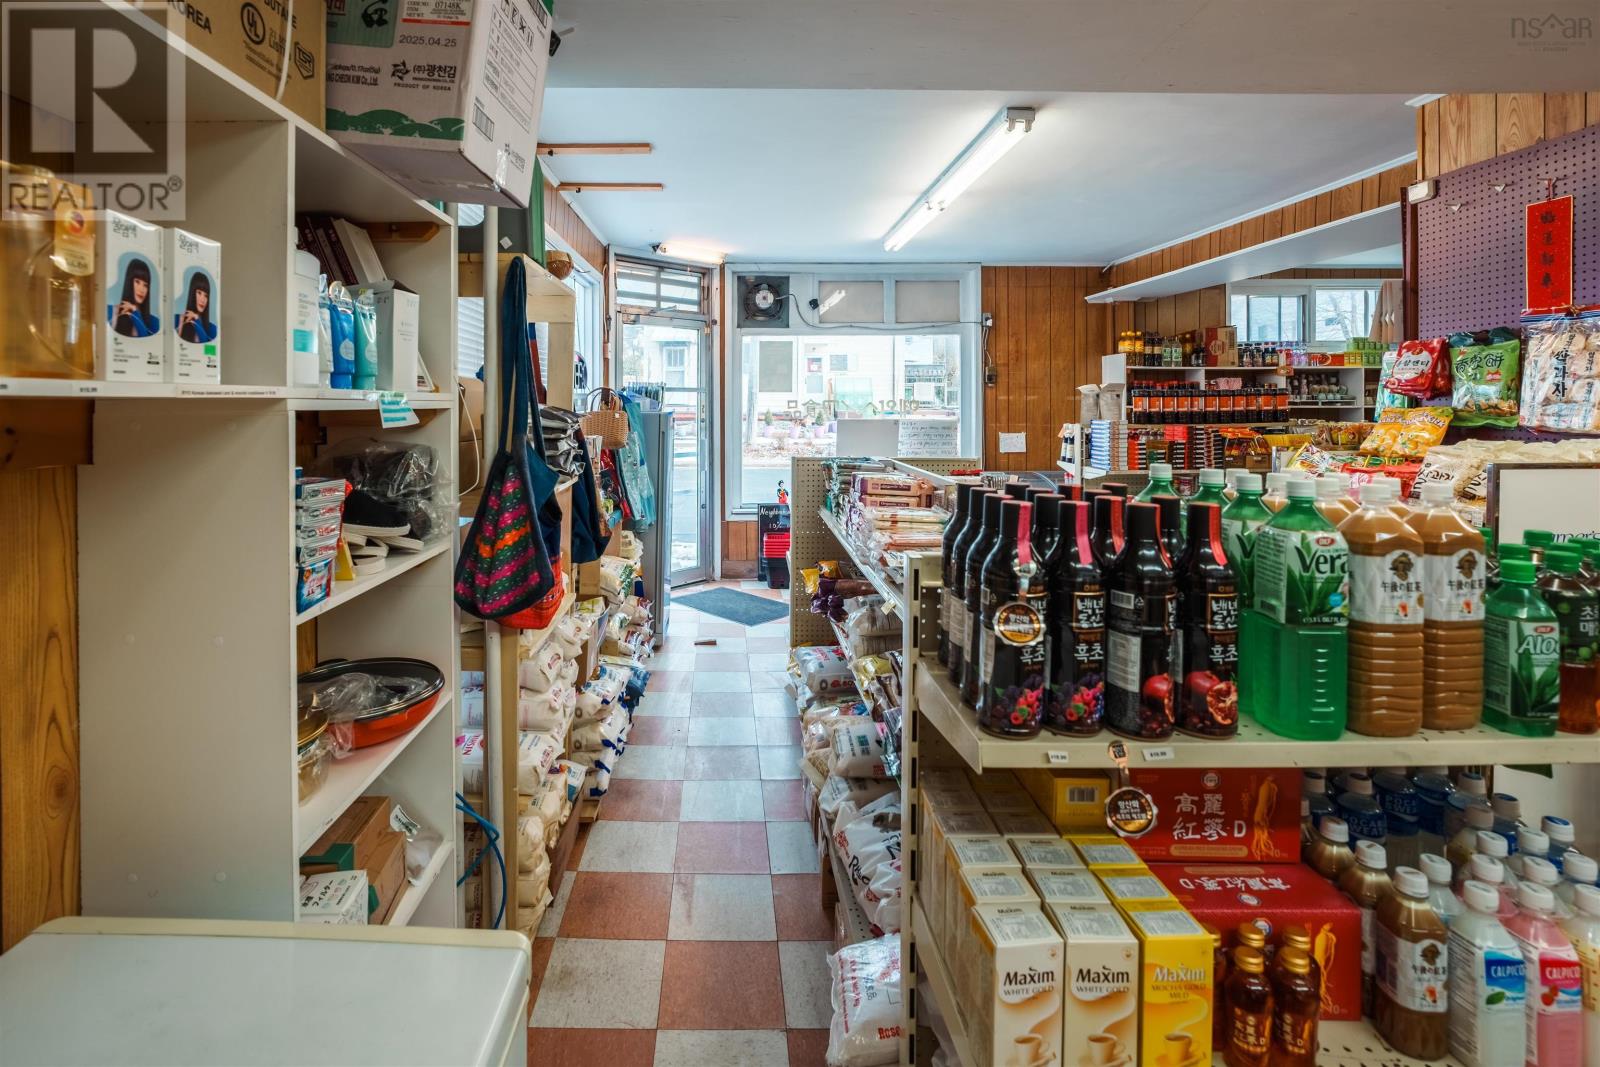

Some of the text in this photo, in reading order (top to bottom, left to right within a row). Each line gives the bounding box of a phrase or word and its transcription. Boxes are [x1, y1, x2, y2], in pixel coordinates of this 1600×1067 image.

[398, 34, 457, 48] 2025.04.25
[1020, 644, 1045, 665] 흑초
[1074, 643, 1104, 663] 흑초
[1209, 644, 1238, 665] 흑초
[1174, 793, 1226, 815] 高麗
[1003, 966, 1055, 986] Maxim
[1076, 965, 1130, 984] Maxim
[1152, 964, 1206, 983] Maxim
[1490, 965, 1526, 978] CALPICO
[1003, 985, 1055, 997] WHITE GOLD
[1076, 985, 1130, 994] WHITE GOLD
[1151, 984, 1182, 992] MOCHA
